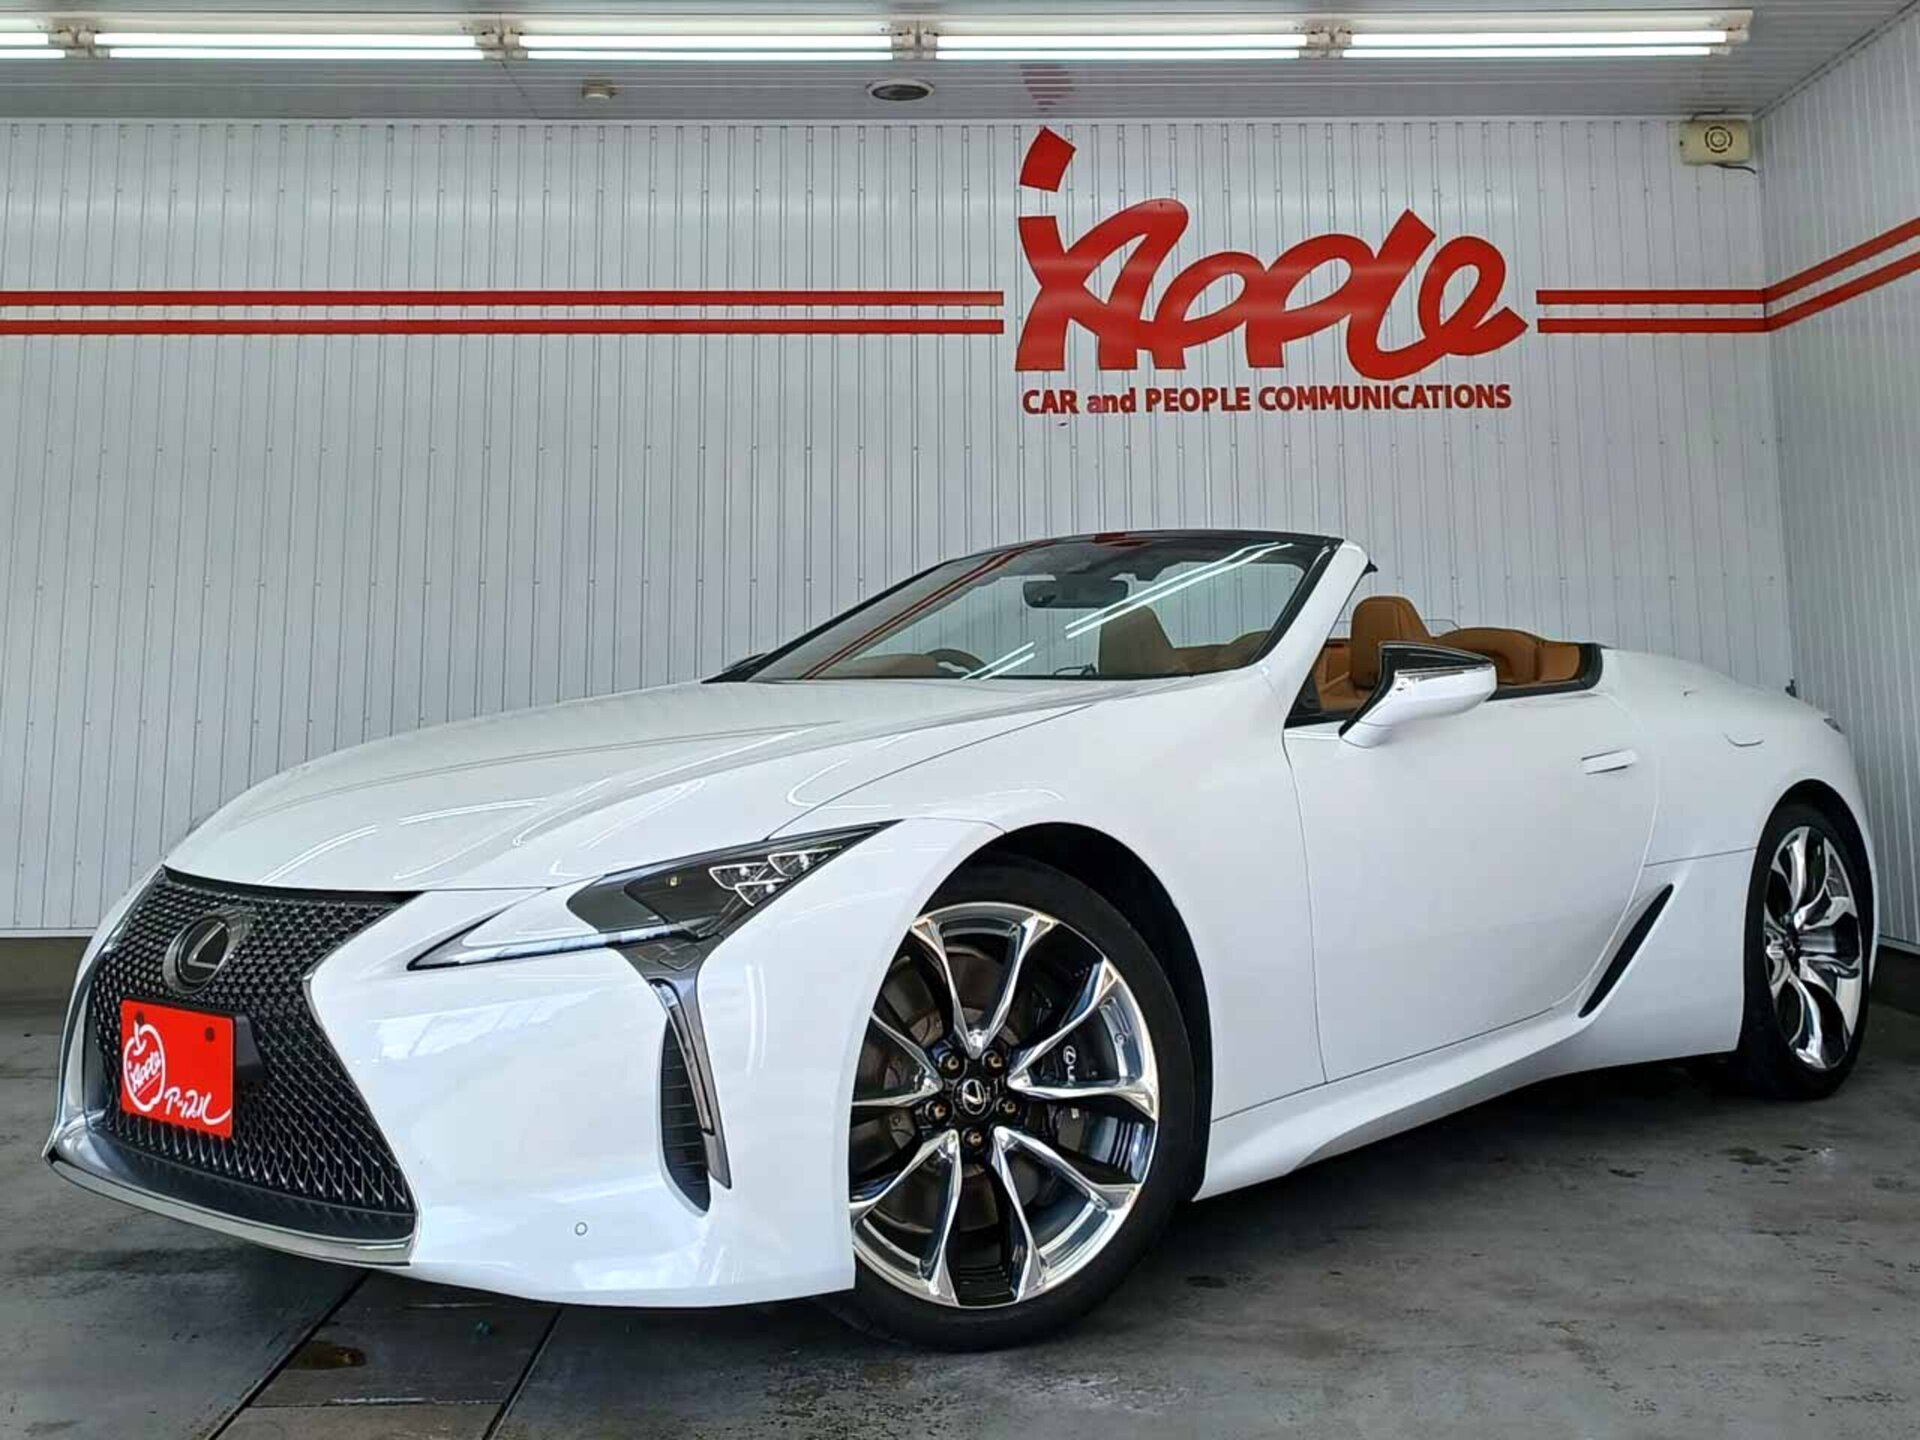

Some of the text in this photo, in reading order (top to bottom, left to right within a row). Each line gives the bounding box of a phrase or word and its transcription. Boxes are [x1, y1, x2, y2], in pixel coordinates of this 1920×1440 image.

[1022, 383, 1512, 414] CAR and PEOPLE COMMUNICATIONS
